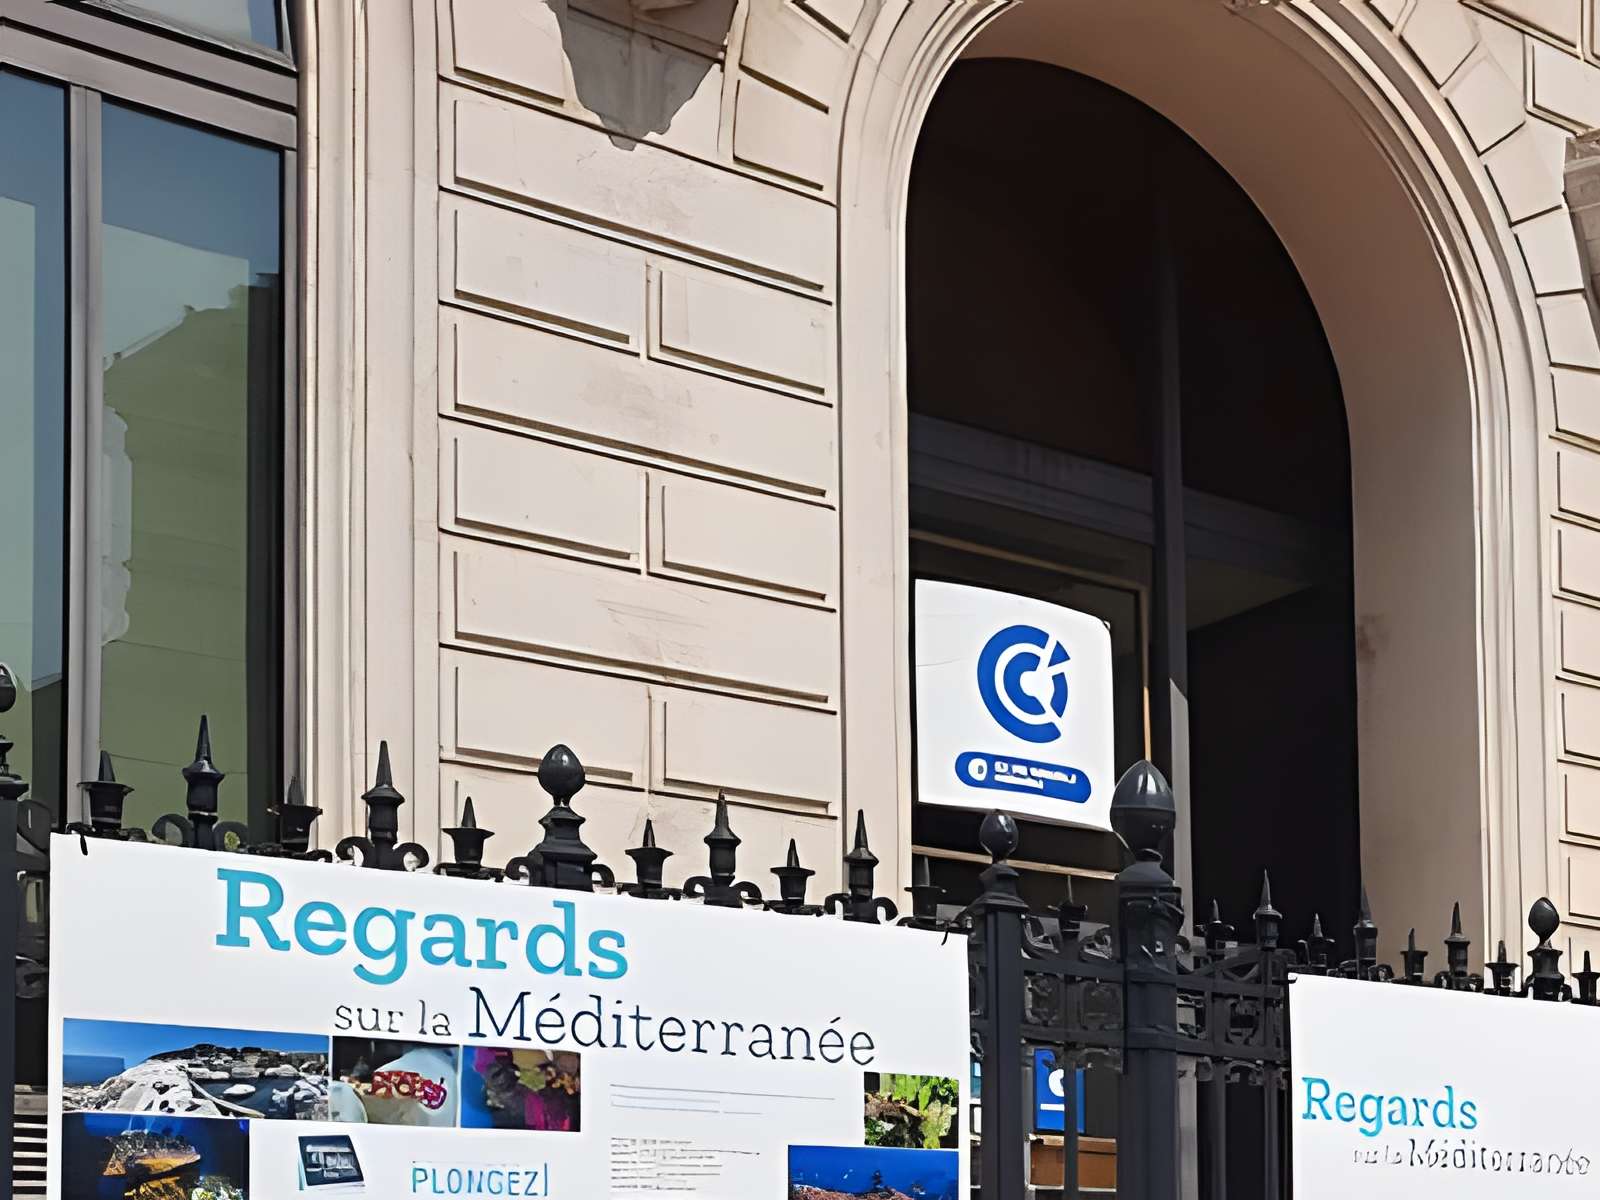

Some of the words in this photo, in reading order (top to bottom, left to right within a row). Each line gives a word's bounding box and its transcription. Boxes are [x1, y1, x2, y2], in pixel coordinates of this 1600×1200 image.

[216, 867, 629, 985] Regards
[335, 1005, 403, 1033] sur
[419, 999, 452, 1036] la
[468, 985, 876, 1066] Méditerranée
[1302, 1077, 1478, 1138] Regards
